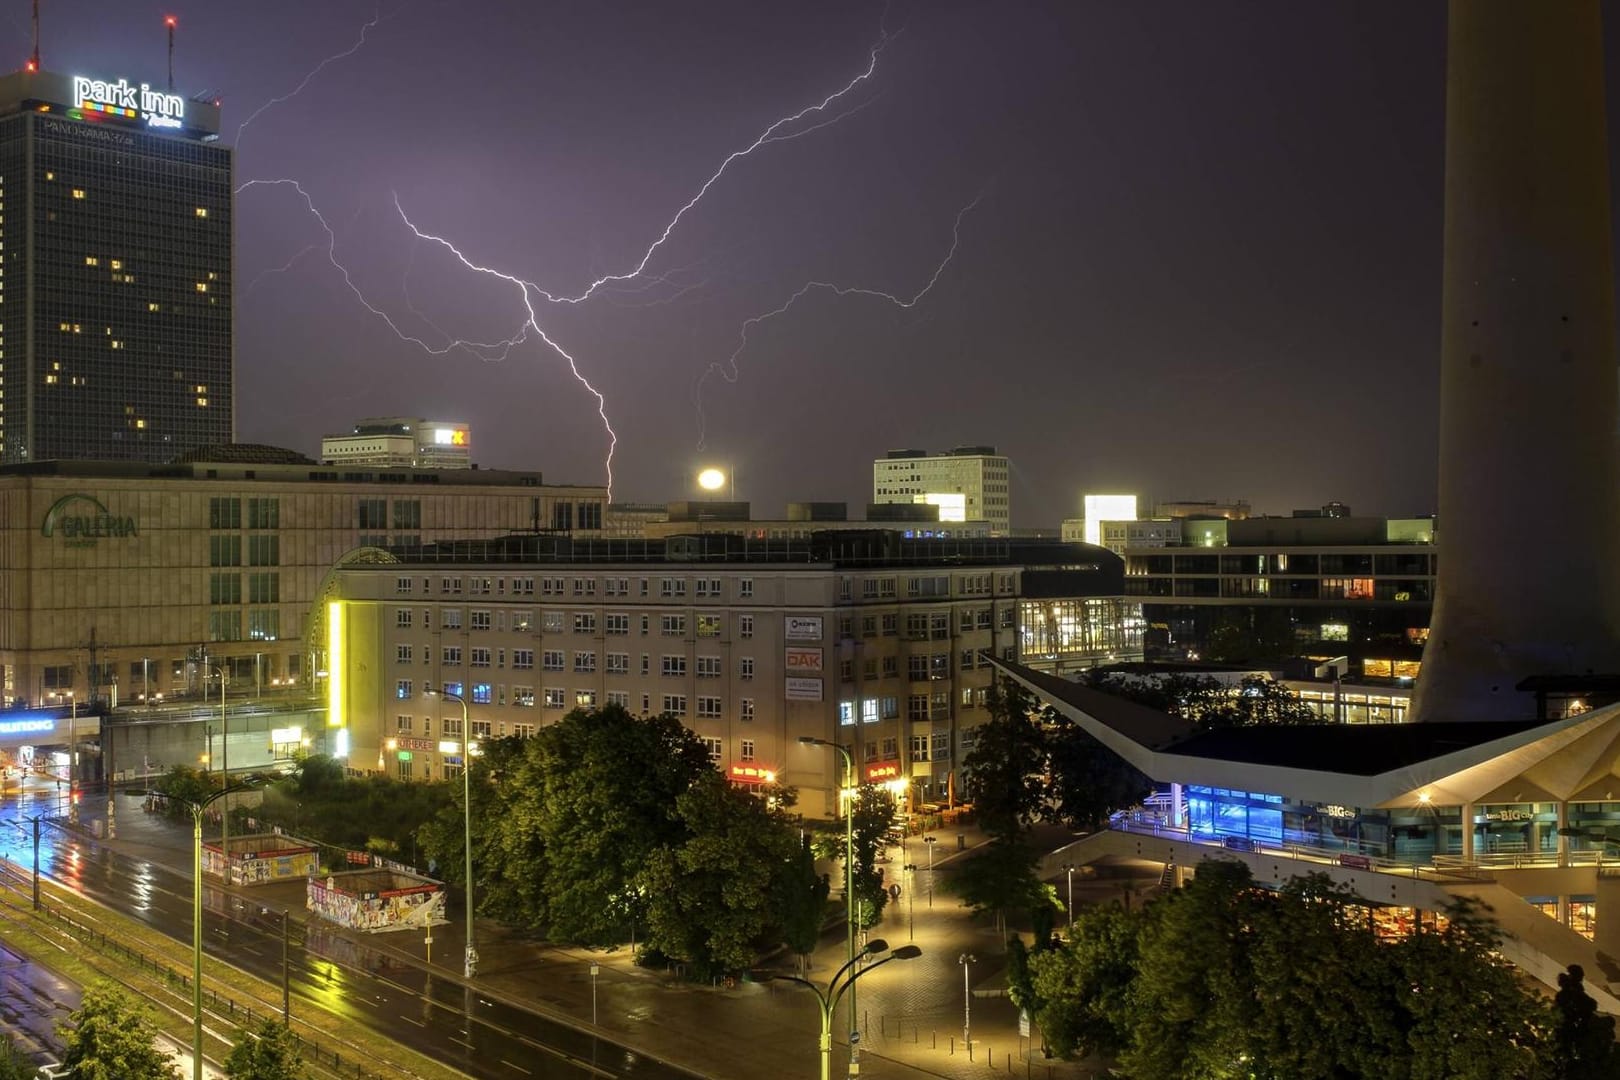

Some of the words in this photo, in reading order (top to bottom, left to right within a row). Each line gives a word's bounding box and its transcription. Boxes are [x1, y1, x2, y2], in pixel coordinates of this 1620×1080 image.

[74, 76, 138, 109] park
[141, 83, 184, 117] inn
[62, 515, 137, 538] GALERIA
[787, 654, 820, 668] DAK
[1327, 805, 1345, 818] BIG
[1501, 810, 1521, 821] BIG
